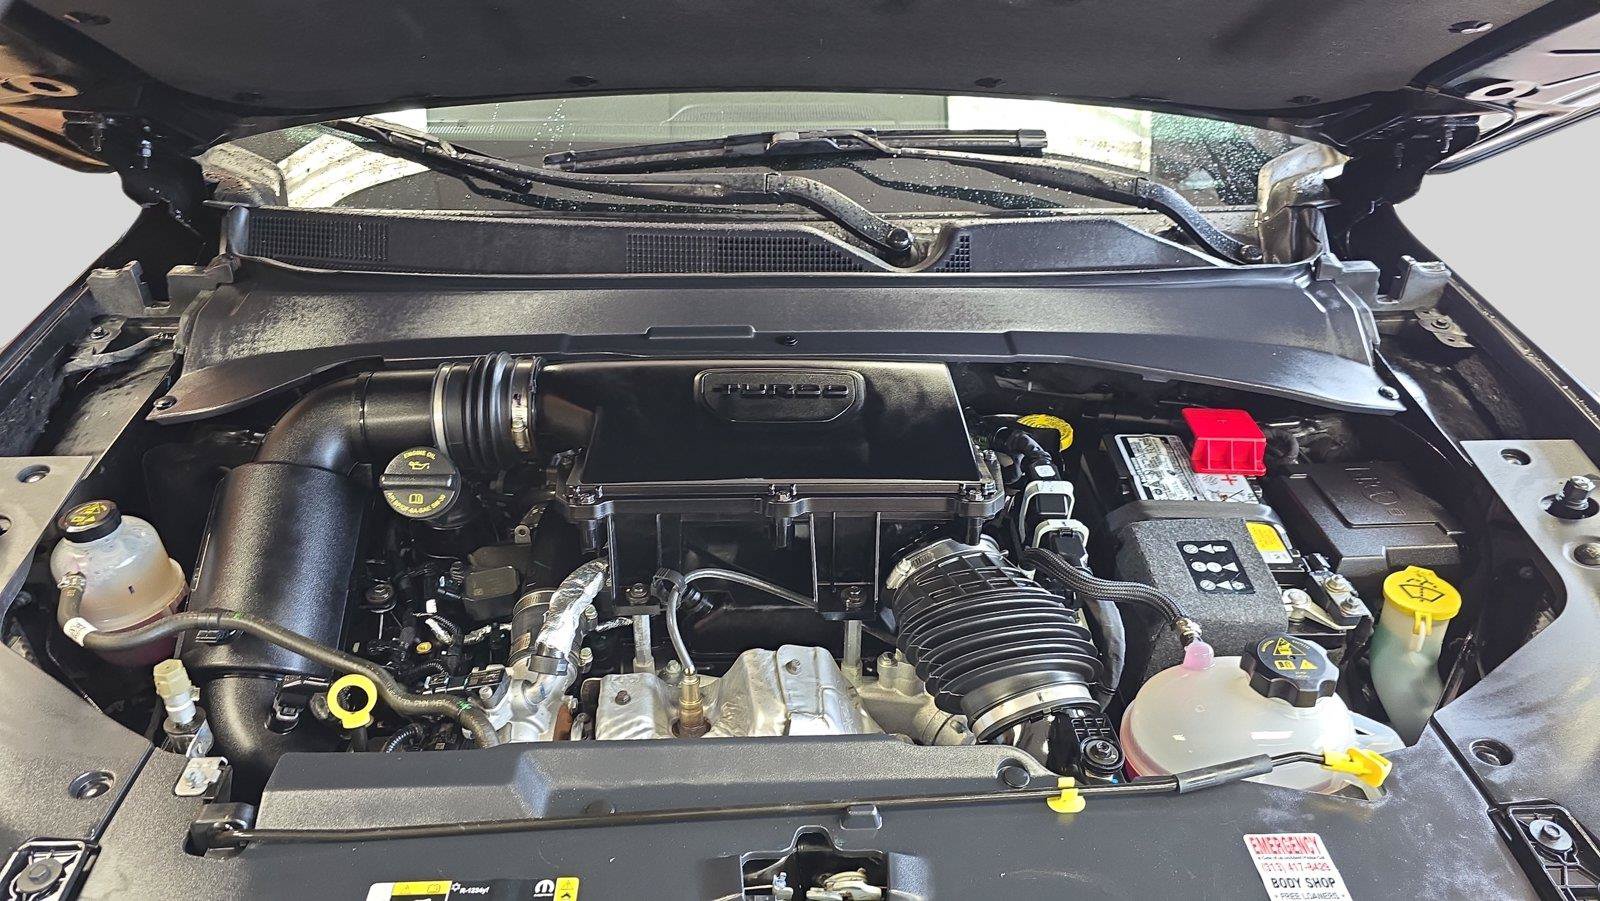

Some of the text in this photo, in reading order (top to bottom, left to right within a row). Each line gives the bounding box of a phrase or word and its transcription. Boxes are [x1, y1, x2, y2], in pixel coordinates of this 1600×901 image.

[403, 450, 436, 460] ENGINE OIL
[1249, 837, 1321, 855] EMERGENCY
[1270, 878, 1335, 889] BODY SHOP
[1280, 892, 1302, 900] FREE
